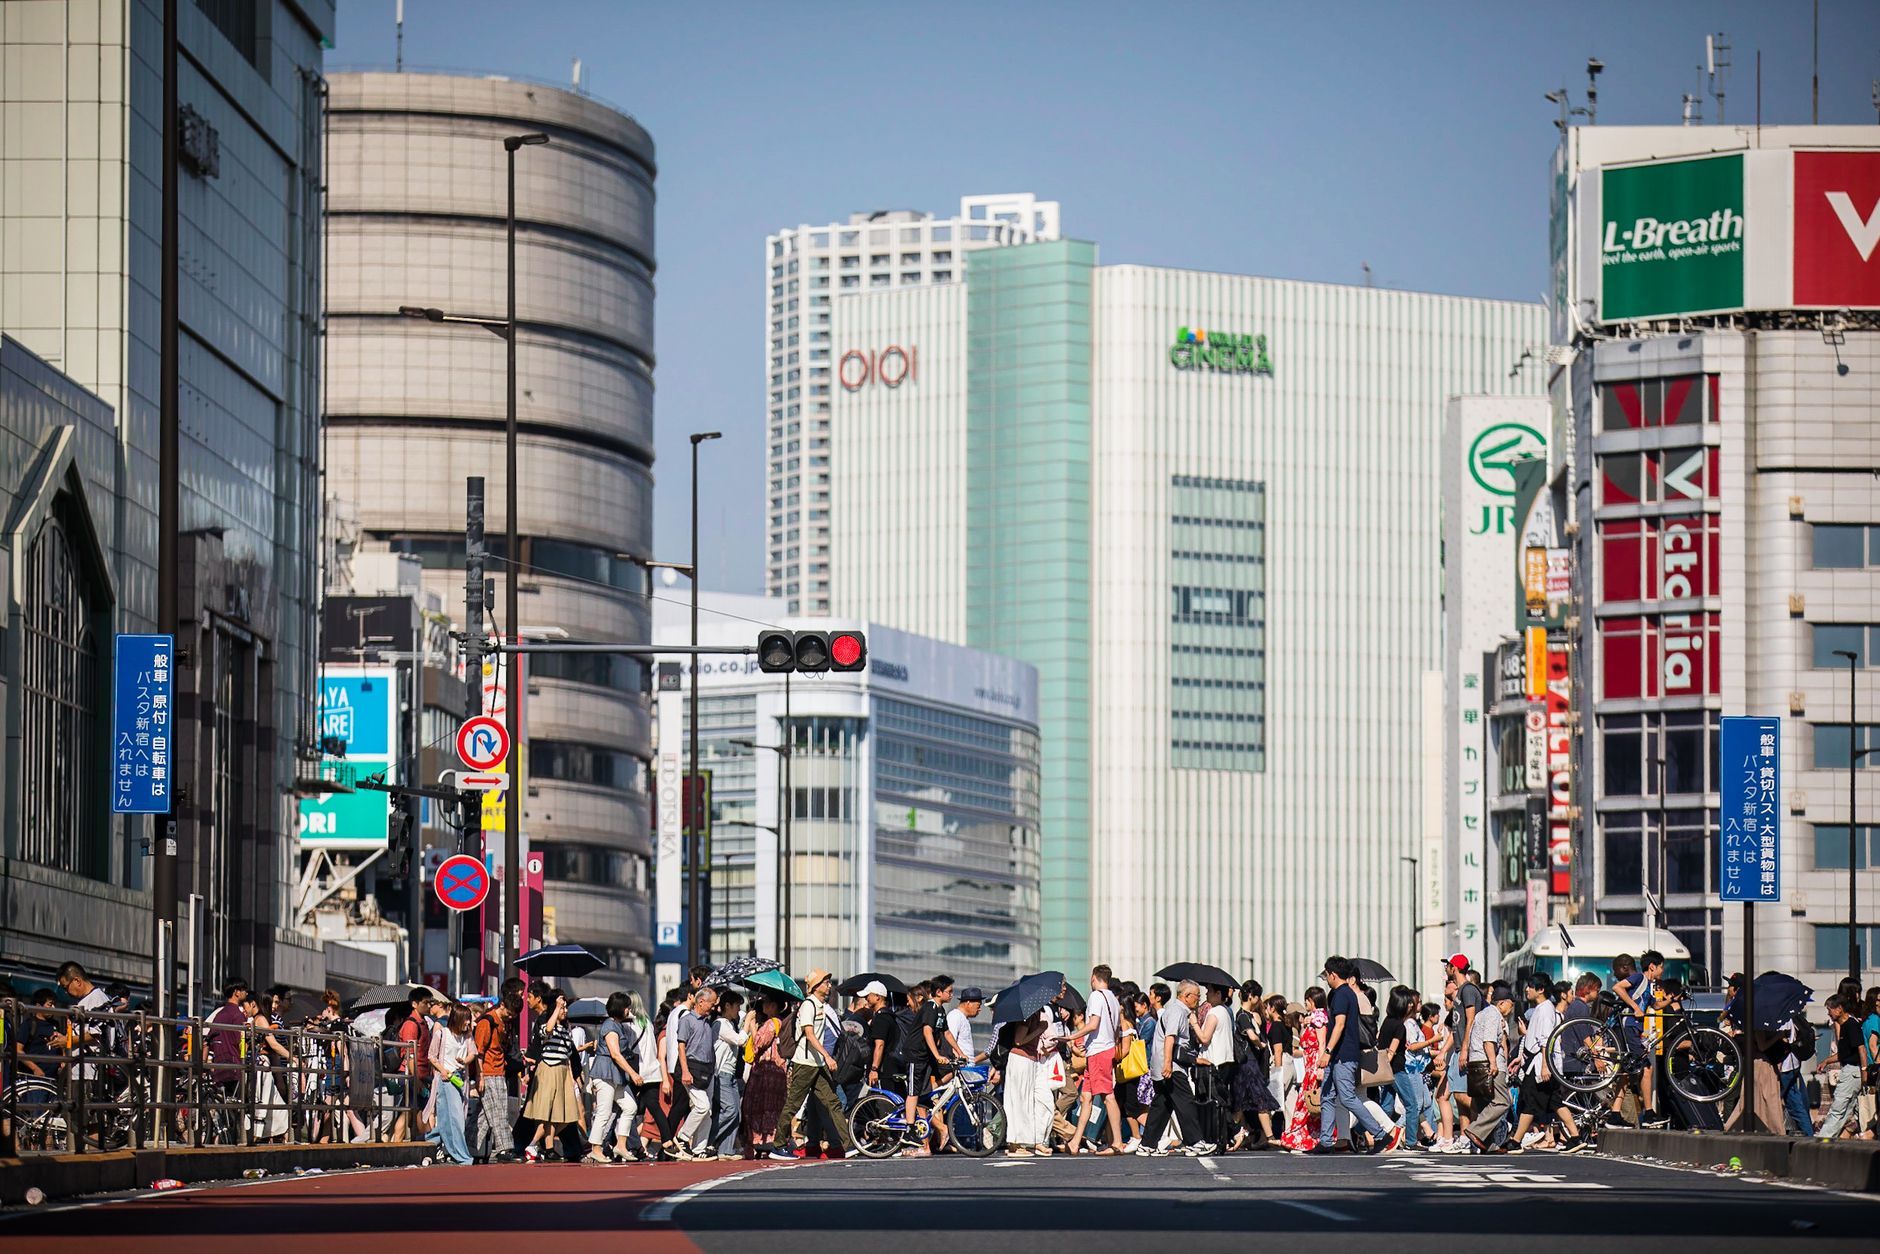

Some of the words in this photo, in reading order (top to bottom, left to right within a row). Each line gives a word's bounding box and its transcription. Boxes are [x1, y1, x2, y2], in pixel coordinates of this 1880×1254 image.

[1170, 343, 1273, 377] CINEMA
[1469, 504, 1516, 535] JR
[135, 671, 151, 778] バスタ新宿へは
[151, 642, 168, 797] 一般車・原付・自転車は
[118, 731, 134, 808] 入れません
[1743, 755, 1757, 864] バスタ新宿へは
[1759, 725, 1775, 895] 一般車・貸切バス・大型貨物車は
[1726, 817, 1741, 895] 入れません
